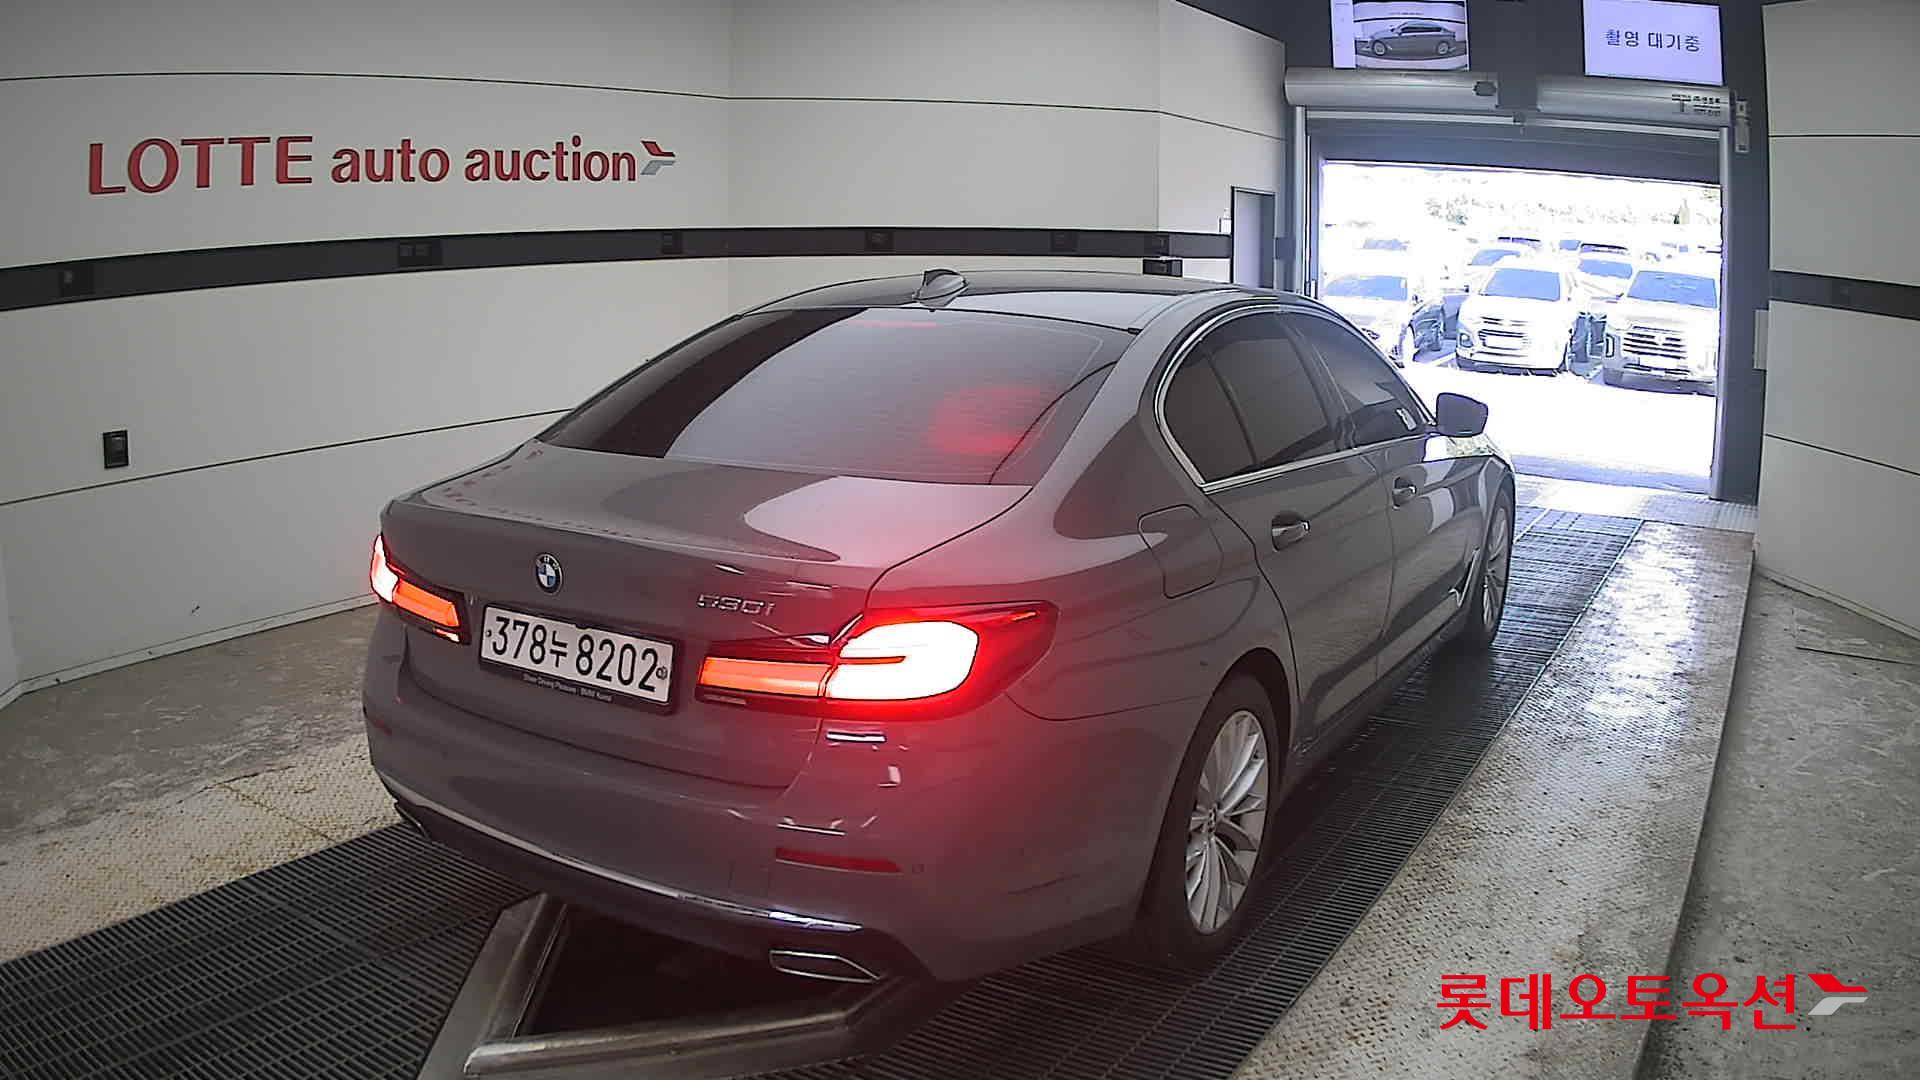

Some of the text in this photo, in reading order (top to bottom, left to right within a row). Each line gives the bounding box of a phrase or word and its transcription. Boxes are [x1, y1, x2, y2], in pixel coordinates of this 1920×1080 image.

[1647, 31, 1700, 52] 대기중
[88, 135, 637, 195] LOTTE auto auction
[575, 633, 656, 692] 8202
